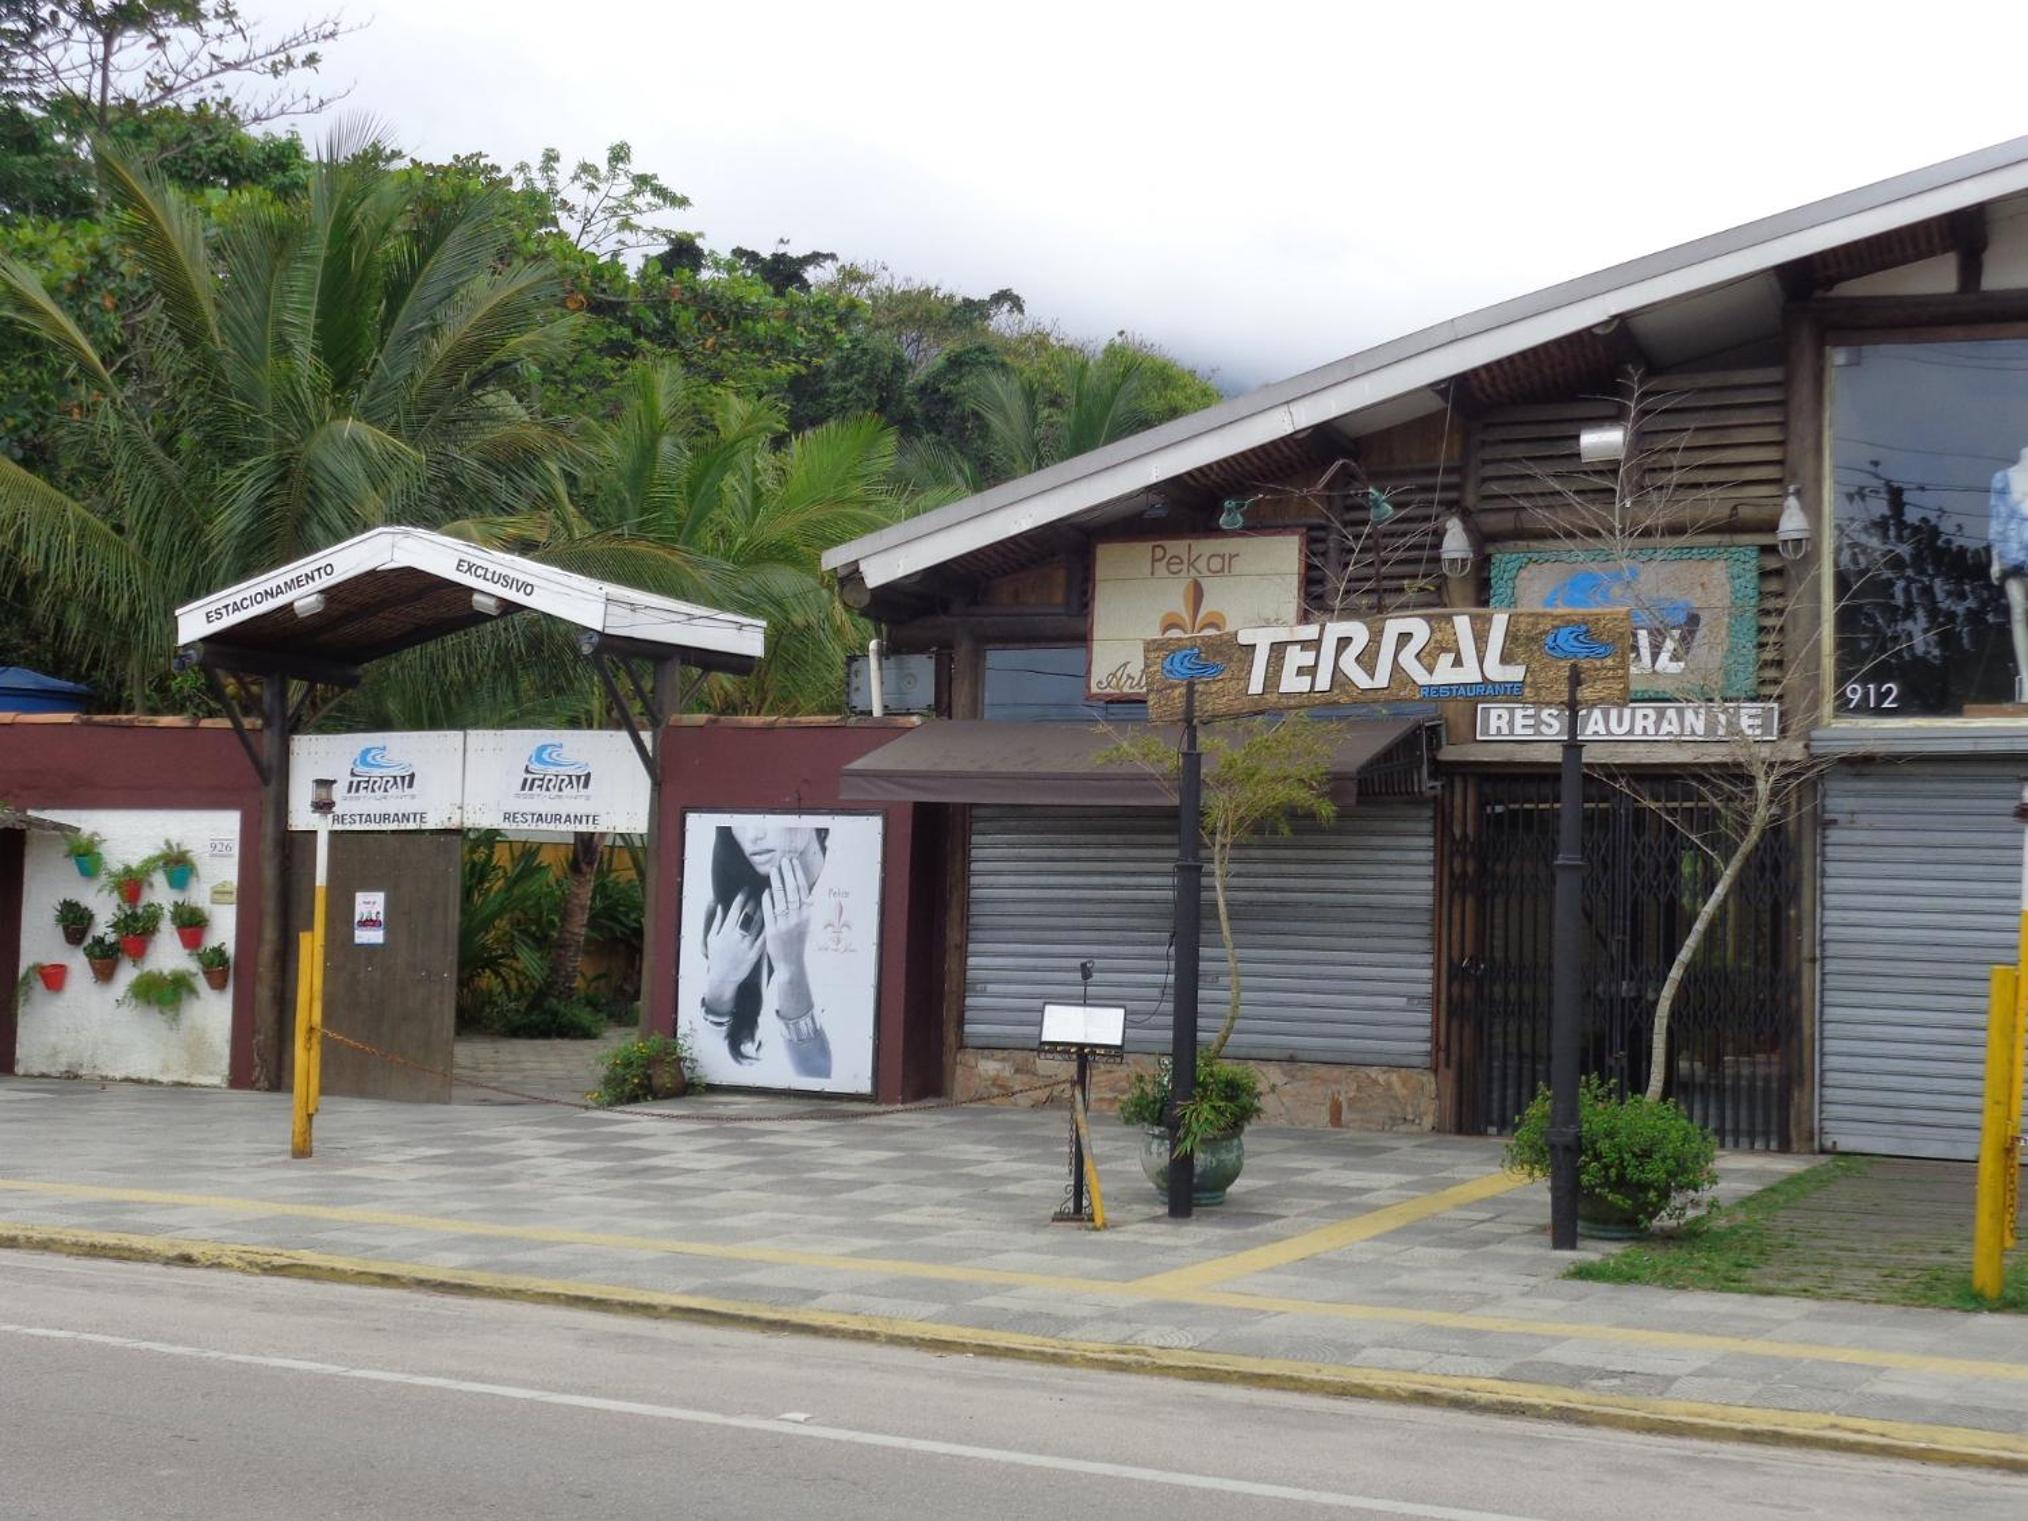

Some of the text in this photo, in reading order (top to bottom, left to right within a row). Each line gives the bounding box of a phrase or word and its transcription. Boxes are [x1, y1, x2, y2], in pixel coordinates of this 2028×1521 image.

[1150, 543, 1240, 576] Pekar
[455, 559, 535, 597] EXCLUSIVO
[205, 563, 335, 624] ESTACIONAMENTO
[1236, 613, 1527, 695] TERRAL
[1420, 683, 1523, 698] RESTAURANTE
[1846, 683, 1899, 709] 912
[1488, 707, 1763, 736] RESAURANTE
[332, 812, 428, 826] RESTAURANTE
[502, 811, 600, 825] RESTAURANTE
[210, 841, 232, 852] 926
